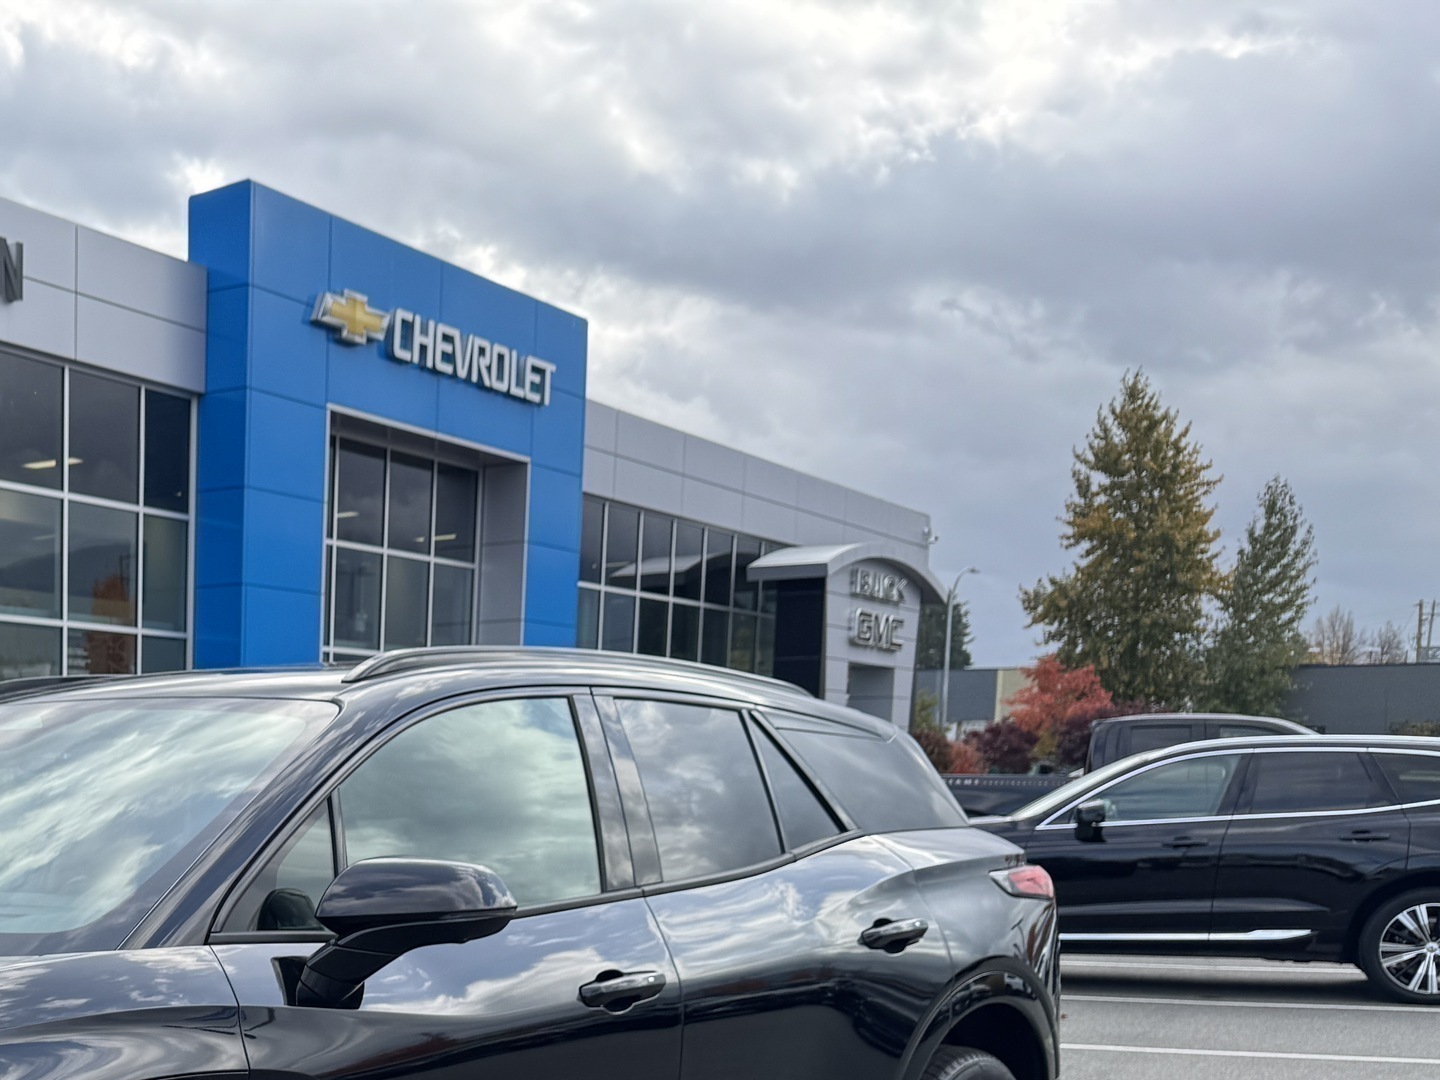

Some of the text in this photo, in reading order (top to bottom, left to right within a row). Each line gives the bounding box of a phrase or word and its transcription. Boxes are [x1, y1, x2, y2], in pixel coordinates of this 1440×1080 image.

[393, 308, 557, 406] CHEVROLET
[852, 567, 908, 602] BUICK
[853, 607, 904, 651] GMC
